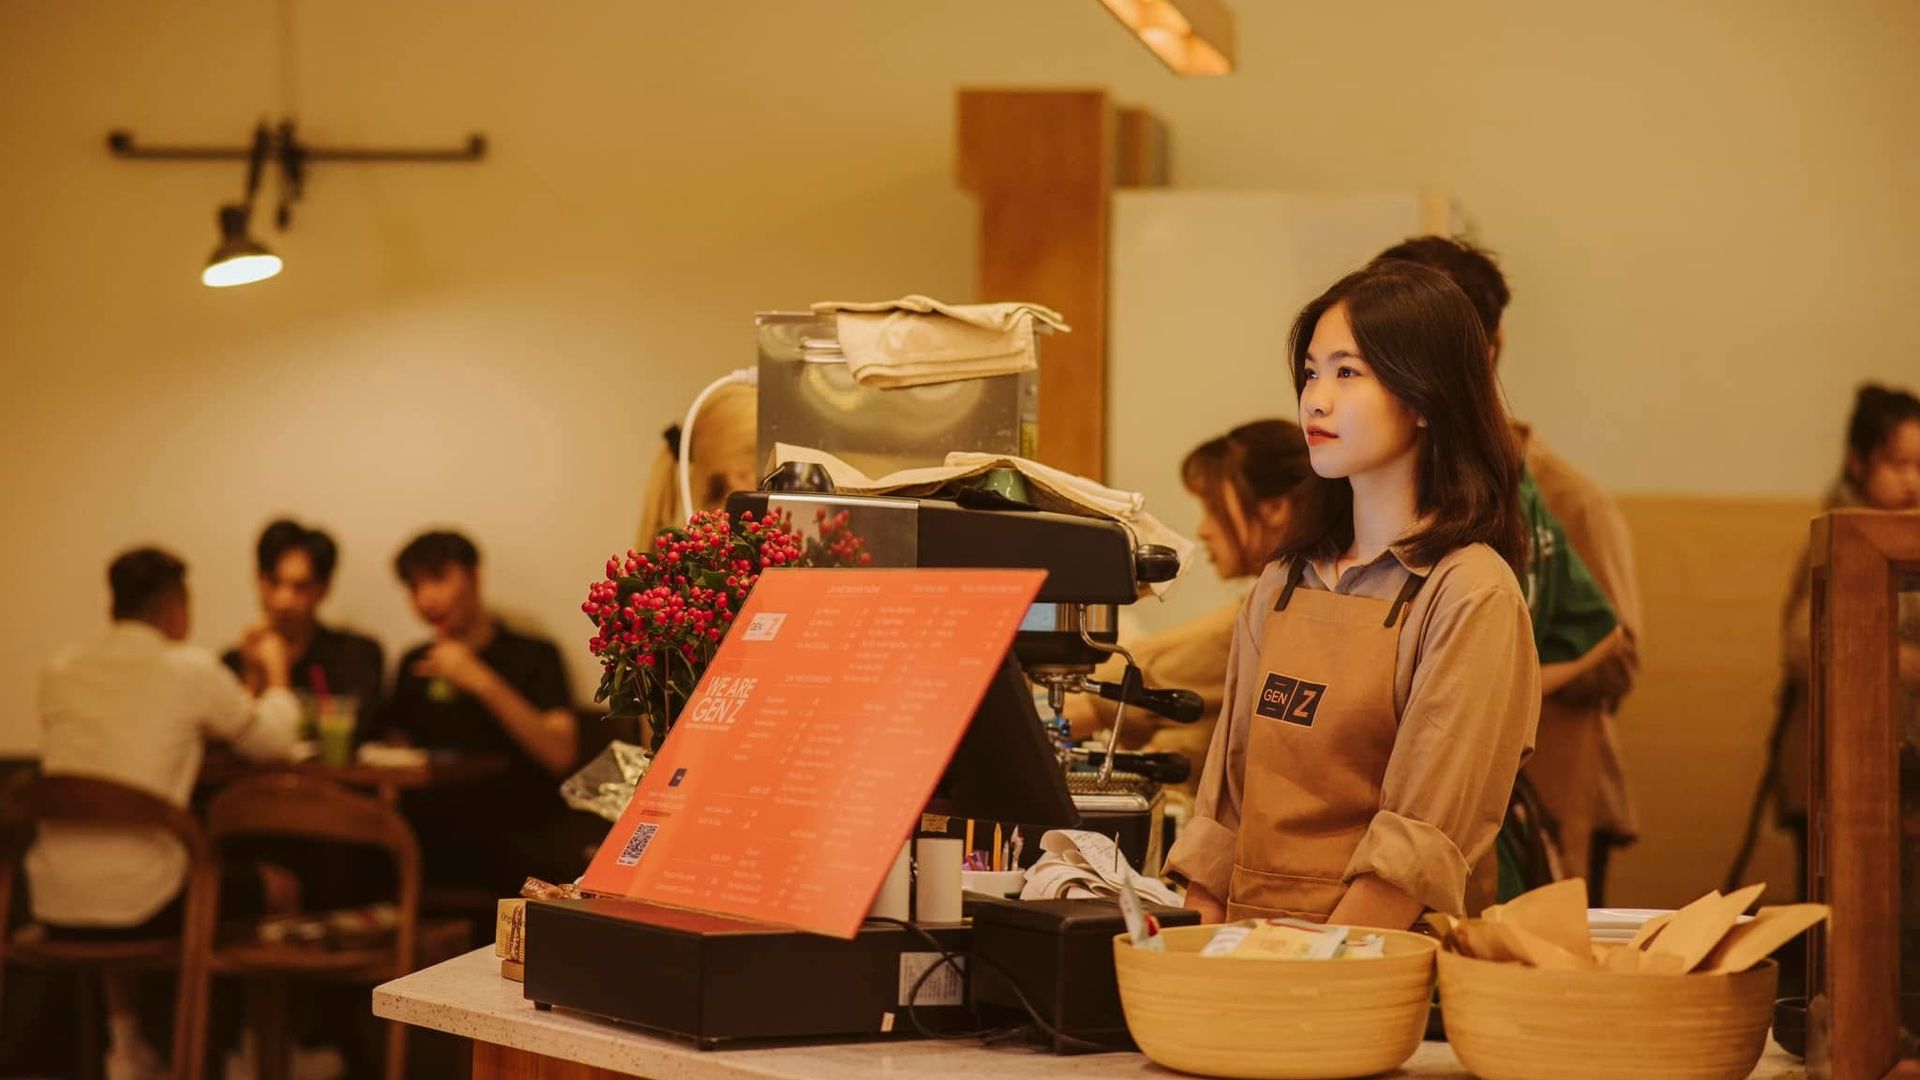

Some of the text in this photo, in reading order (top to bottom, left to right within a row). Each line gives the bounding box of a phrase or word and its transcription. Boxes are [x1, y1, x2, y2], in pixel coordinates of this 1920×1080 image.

[764, 618, 781, 635] Z
[705, 675, 758, 698] WE ARE
[691, 697, 733, 722] GEN
[726, 699, 747, 723] Z
[1264, 689, 1317, 718] GEN Z
